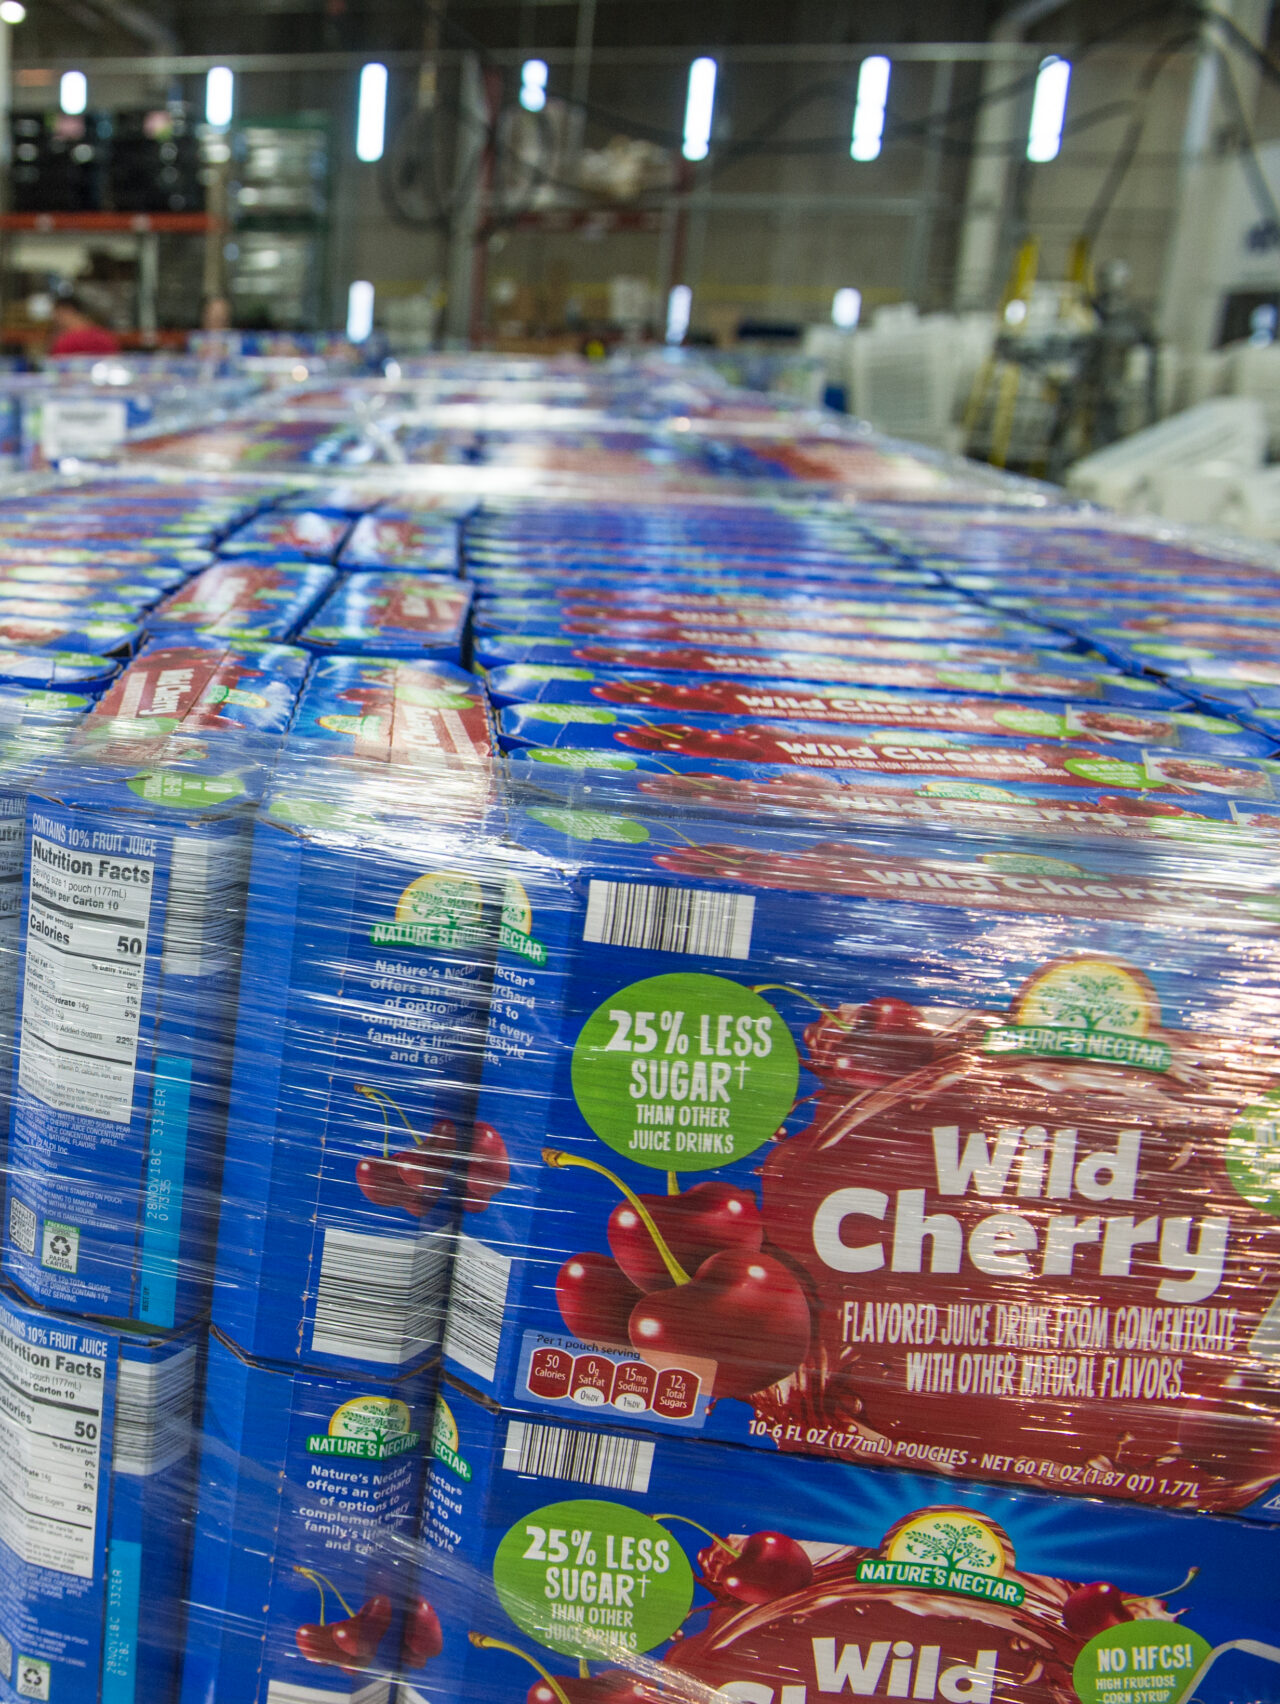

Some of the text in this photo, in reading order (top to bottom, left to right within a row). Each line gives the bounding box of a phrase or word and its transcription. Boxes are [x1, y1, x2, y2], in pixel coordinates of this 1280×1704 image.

[736, 694, 980, 721] Wild Cherry
[775, 741, 1048, 770] Wild Cherry
[32, 812, 157, 857] CONTAINS 10% FRUIT JUICE
[32, 839, 151, 884] Nutrition Facts
[58, 892, 71, 906] per
[72, 895, 104, 910] Carton
[107, 900, 119, 911] 10
[68, 881, 93, 898] pouch
[93, 883, 128, 901] (177mL)
[30, 914, 143, 956] Calories 50
[373, 924, 450, 946] NATURE'S
[375, 959, 440, 979] Nature's
[370, 978, 440, 996] offers an
[505, 1005, 520, 1021] to
[499, 1021, 535, 1048] every
[605, 1009, 773, 1058] 25% LESS
[389, 1050, 420, 1064] and
[636, 1103, 730, 1128] THAN OTHER
[628, 1129, 735, 1155] JUICE DRINKS
[931, 1125, 1144, 1201] Wild
[811, 1186, 1232, 1303] Cherry
[45, 1258, 73, 1272] CARTON
[842, 1300, 1239, 1353] FLAVORED JUICE DRINK FROM CONCENTRATE
[27, 1326, 48, 1345] 10%
[49, 1330, 78, 1352] FRUIT
[79, 1337, 109, 1358] JUICE
[535, 1333, 557, 1345] Per
[564, 1337, 600, 1354] pouch
[601, 1344, 641, 1362] serving
[55, 1354, 102, 1380] Facts
[545, 1353, 560, 1369] 50
[587, 1360, 600, 1378] 0g
[29, 1370, 83, 1392] pouch (177mL)
[534, 1366, 567, 1381] Calories
[578, 1374, 606, 1388] Sat Fat
[624, 1366, 648, 1386] 15mg
[669, 1374, 687, 1392] 12g
[906, 1351, 1184, 1400] WITH OTHER NATURAL FLAVORS
[32, 1382, 62, 1398] Carton
[64, 1389, 76, 1400] 10
[617, 1380, 650, 1395] Sodium
[665, 1387, 686, 1401] Total
[658, 1396, 688, 1410] Sugars
[73, 1420, 98, 1441] 50
[309, 1433, 418, 1459] NATURE'S NECTAR
[747, 1418, 1201, 1500] 10-6 FL OZ (177mL) POUCHES NET 60 FL OZ (1.87 QT) 1.77L
[310, 1464, 370, 1485] Nature's
[306, 1473, 413, 1500] offers an orchard
[319, 1495, 401, 1514] of options to
[436, 1505, 450, 1520] to
[298, 1505, 383, 1527] complement
[304, 1520, 360, 1540] family's
[431, 1515, 464, 1545] every
[325, 1538, 352, 1552] and
[522, 1525, 671, 1574] 25% LESS
[859, 1562, 1018, 1603] NATURE'S NECTAR
[550, 1602, 634, 1628] THAN OTHER
[1096, 1643, 1194, 1673] NO HFCS!
[811, 1636, 999, 1704] Wild
[1095, 1675, 1177, 1691] HIGH FRUCTOSE
[1102, 1690, 1170, 1704] CORN SYRUP
